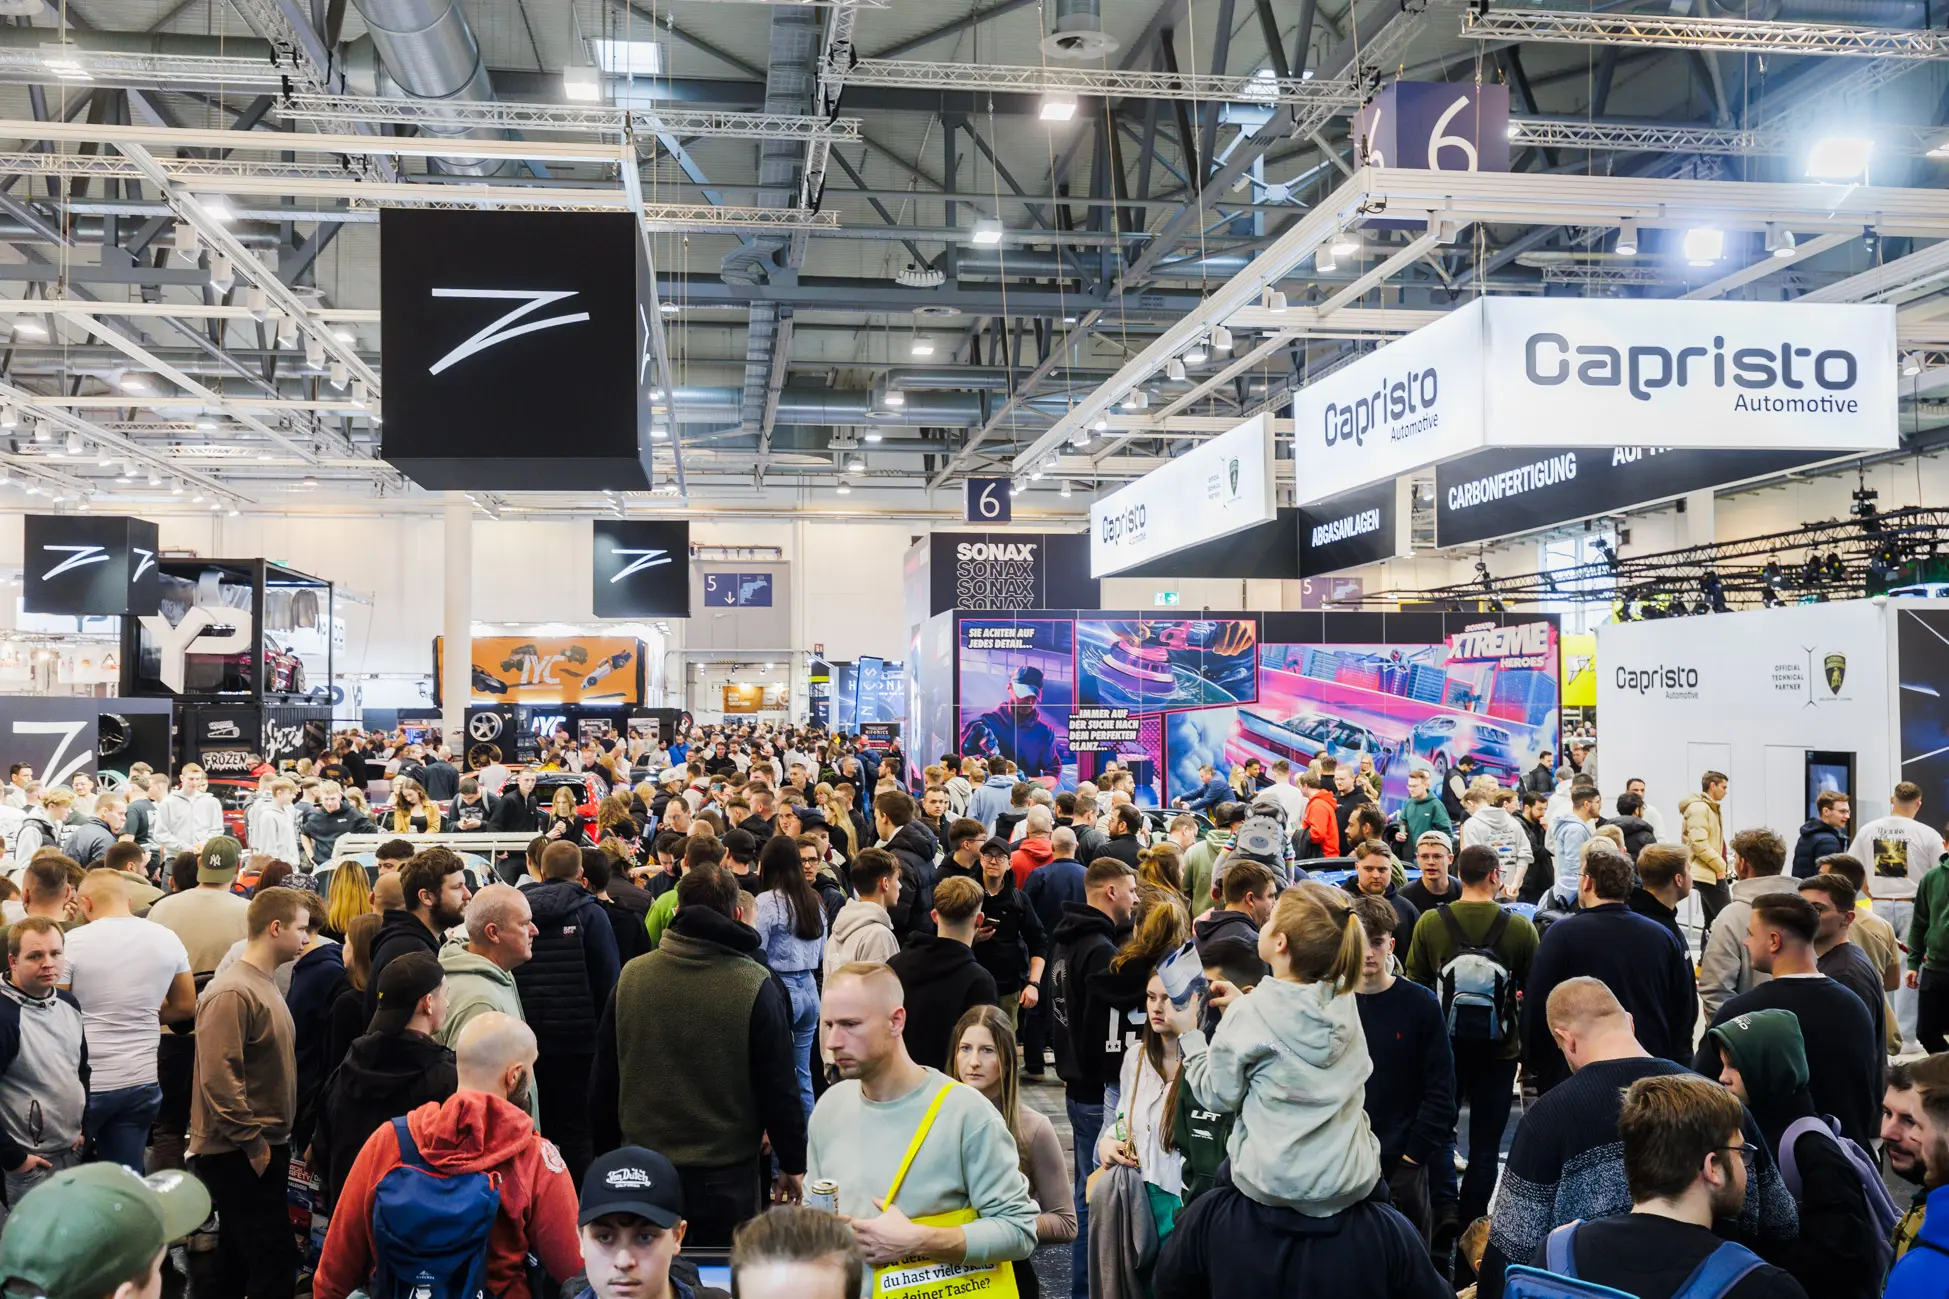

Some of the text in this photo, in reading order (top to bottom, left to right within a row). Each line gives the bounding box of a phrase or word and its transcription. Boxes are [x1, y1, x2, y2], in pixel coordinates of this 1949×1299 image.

[1428, 95, 1478, 171] 6
[1525, 333, 1858, 401] Capristo
[1325, 367, 1438, 447] Capristo
[1734, 394, 1858, 413] Automotive
[1391, 412, 1438, 443] Automotive
[1448, 451, 1577, 511] CARBONFERTIGUNG
[980, 482, 1000, 518] 6
[1103, 504, 1146, 546] Capristo
[1312, 508, 1380, 547] ABGASANLAGEN
[957, 561, 1034, 579] SONAX
[706, 575, 717, 592] 5
[957, 579, 1034, 597] SONAX
[1302, 579, 1313, 595] 5
[968, 628, 1035, 638] SIE ACHTEN AUF
[1448, 621, 1550, 659] XTREME
[968, 639, 1033, 649] JEDES DETAIL...
[1500, 656, 1545, 669] HEROES
[1775, 664, 1801, 672] OFFICIAL
[1616, 664, 1698, 695] Capristo
[1772, 674, 1804, 682] TECHNICAL
[1775, 683, 1801, 691] PARTNER
[1665, 691, 1699, 700] Automotive
[1111, 709, 1129, 719] AUF
[1069, 720, 1139, 730] DER SUCHE NACH
[1069, 731, 1137, 740] DEM PERFEKTEN
[1069, 742, 1108, 752] GLANZ...
[203, 754, 247, 768] FROZEN
[883, 1276, 900, 1289] du
[902, 1269, 931, 1285] hast
[932, 1264, 962, 1279] viele
[945, 1278, 991, 1297] Tasche?
